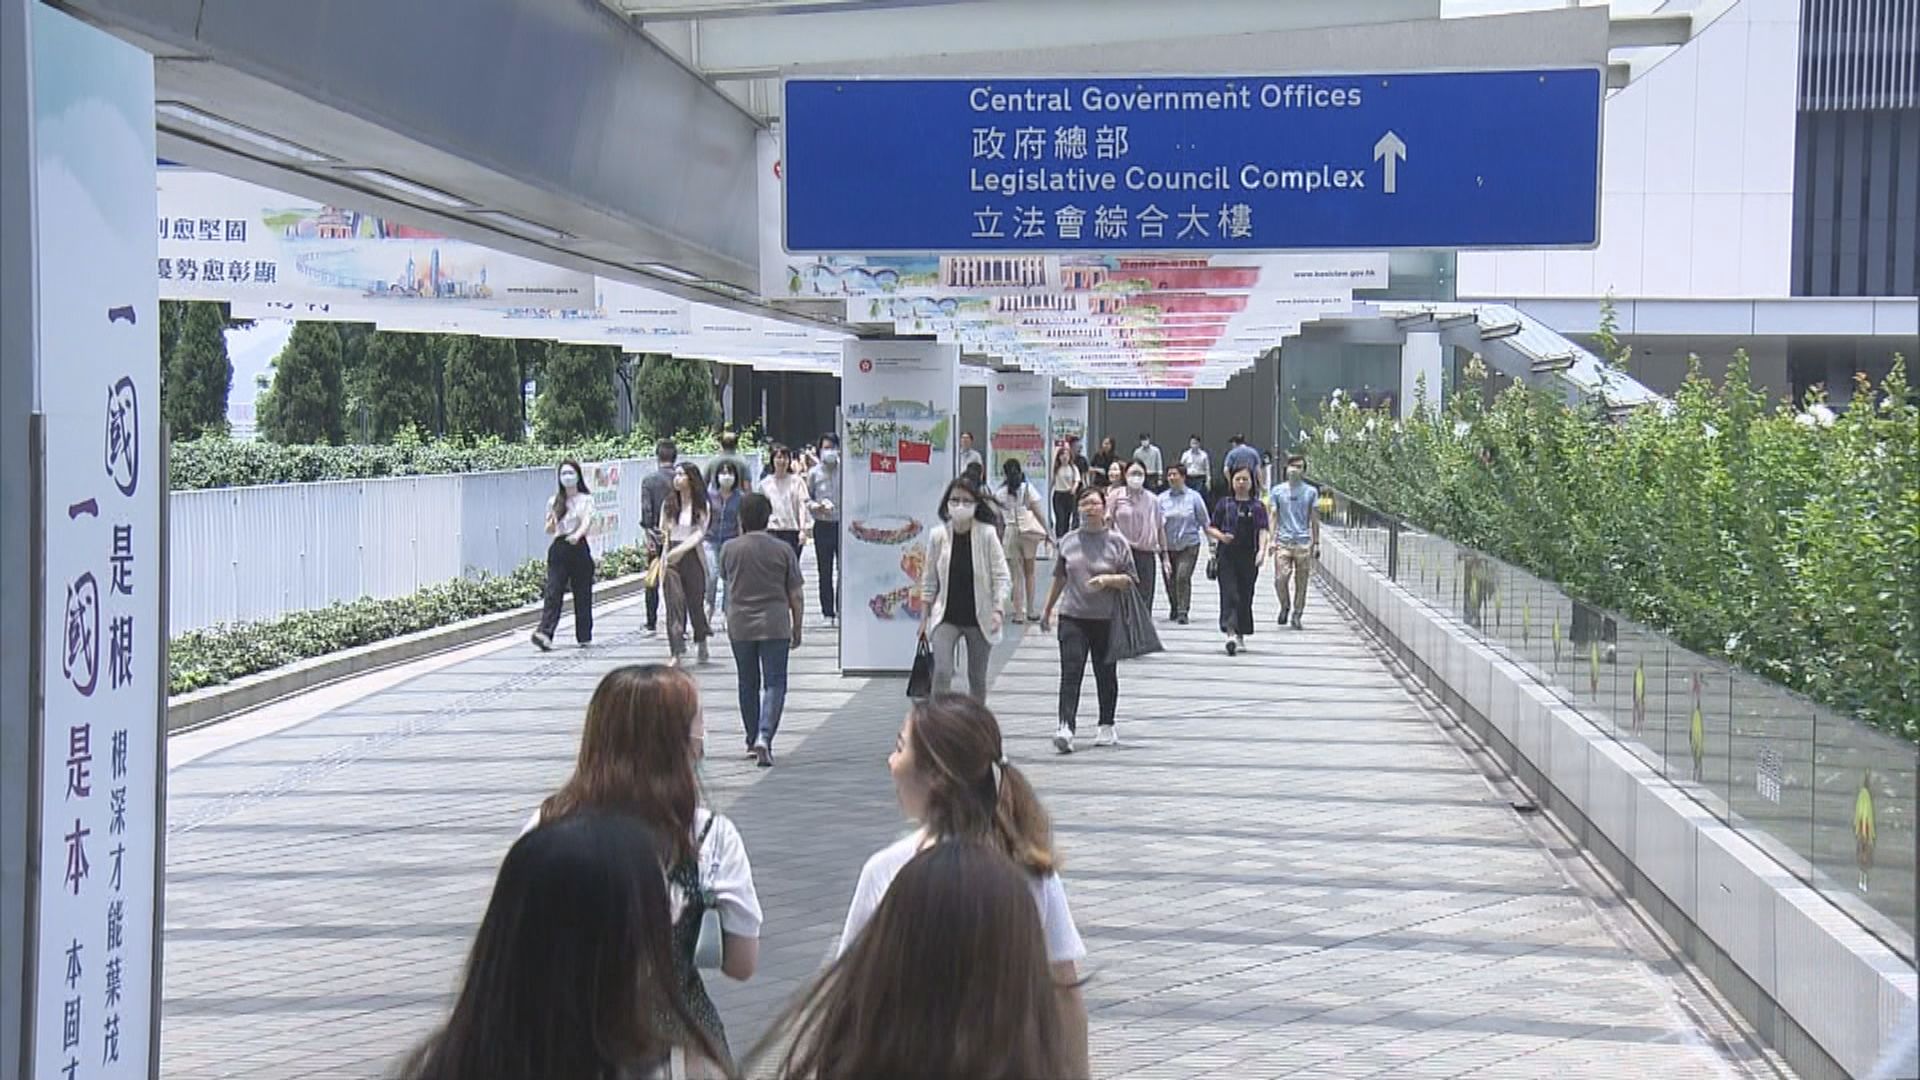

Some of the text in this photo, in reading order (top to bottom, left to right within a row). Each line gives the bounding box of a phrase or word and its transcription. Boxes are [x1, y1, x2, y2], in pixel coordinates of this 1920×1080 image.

[970, 84, 1362, 112] Central Government Offices
[972, 125, 1129, 160] 政府總部
[970, 164, 1365, 195] Legislative Council Complex
[972, 203, 1253, 239] 立法會綜合大樓
[1294, 269, 1375, 278] www.basiclaw.gov.hk
[64, 497, 99, 895] 一國是本
[104, 305, 139, 1068] 一國是根 根深才能葉茂
